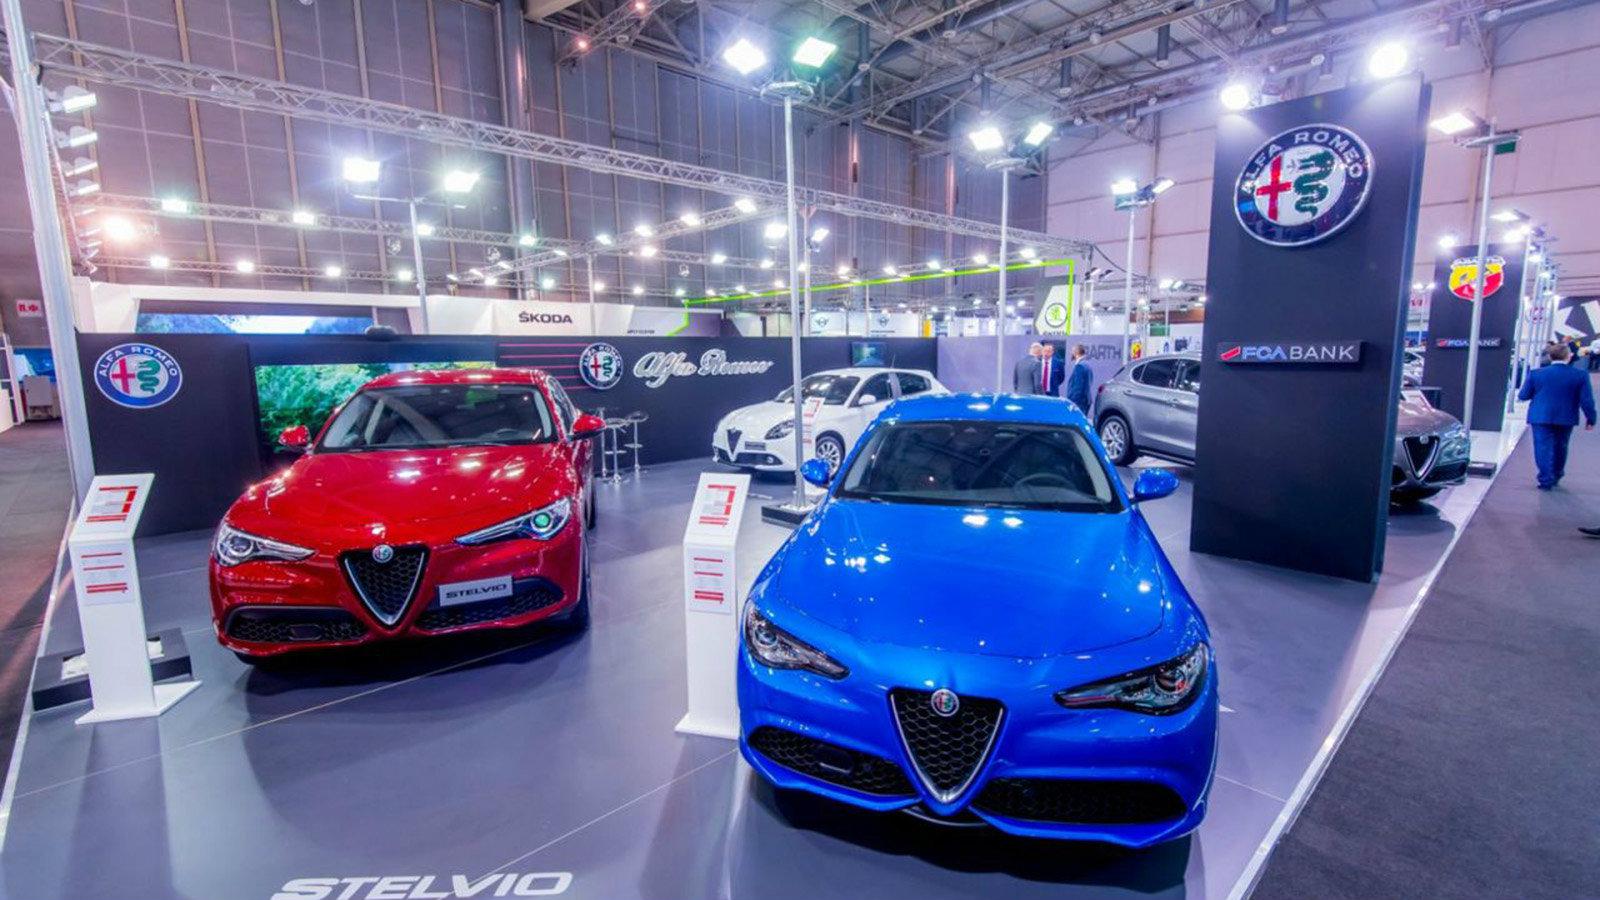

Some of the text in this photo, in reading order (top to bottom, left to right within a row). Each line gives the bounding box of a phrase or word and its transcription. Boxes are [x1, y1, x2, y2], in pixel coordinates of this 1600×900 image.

[1241, 131, 1364, 195] ALFA ROMEO
[518, 311, 573, 324] ŠKODA
[98, 346, 178, 377] ALFA ROMEO
[1084, 344, 1121, 361] BARTH
[1241, 345, 1354, 361] FCA BANK
[632, 348, 775, 389] Alfa Romeo
[445, 583, 507, 599] STELVIO
[269, 871, 574, 900] STELVIO
